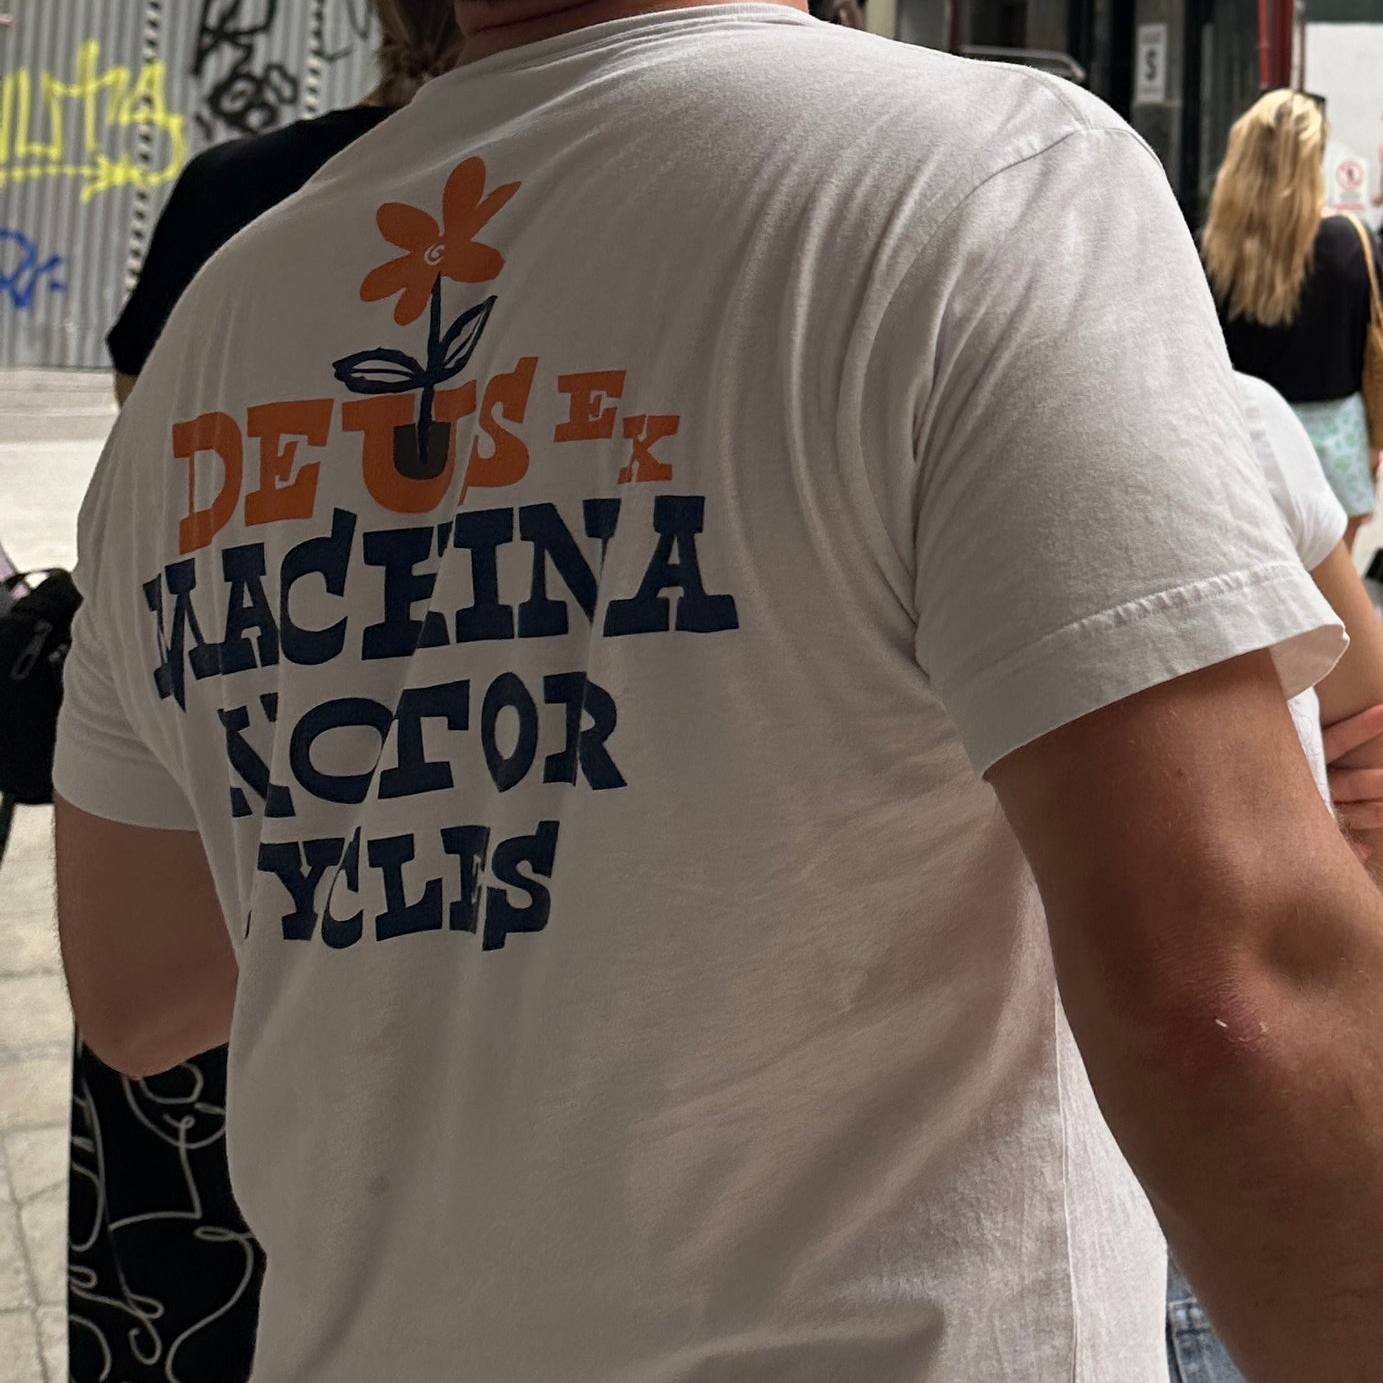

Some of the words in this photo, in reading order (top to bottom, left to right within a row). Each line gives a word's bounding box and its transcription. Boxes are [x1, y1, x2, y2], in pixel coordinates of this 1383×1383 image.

[172, 357, 539, 555] DEUS
[554, 369, 680, 485] EX
[243, 820, 560, 951] YCLES
